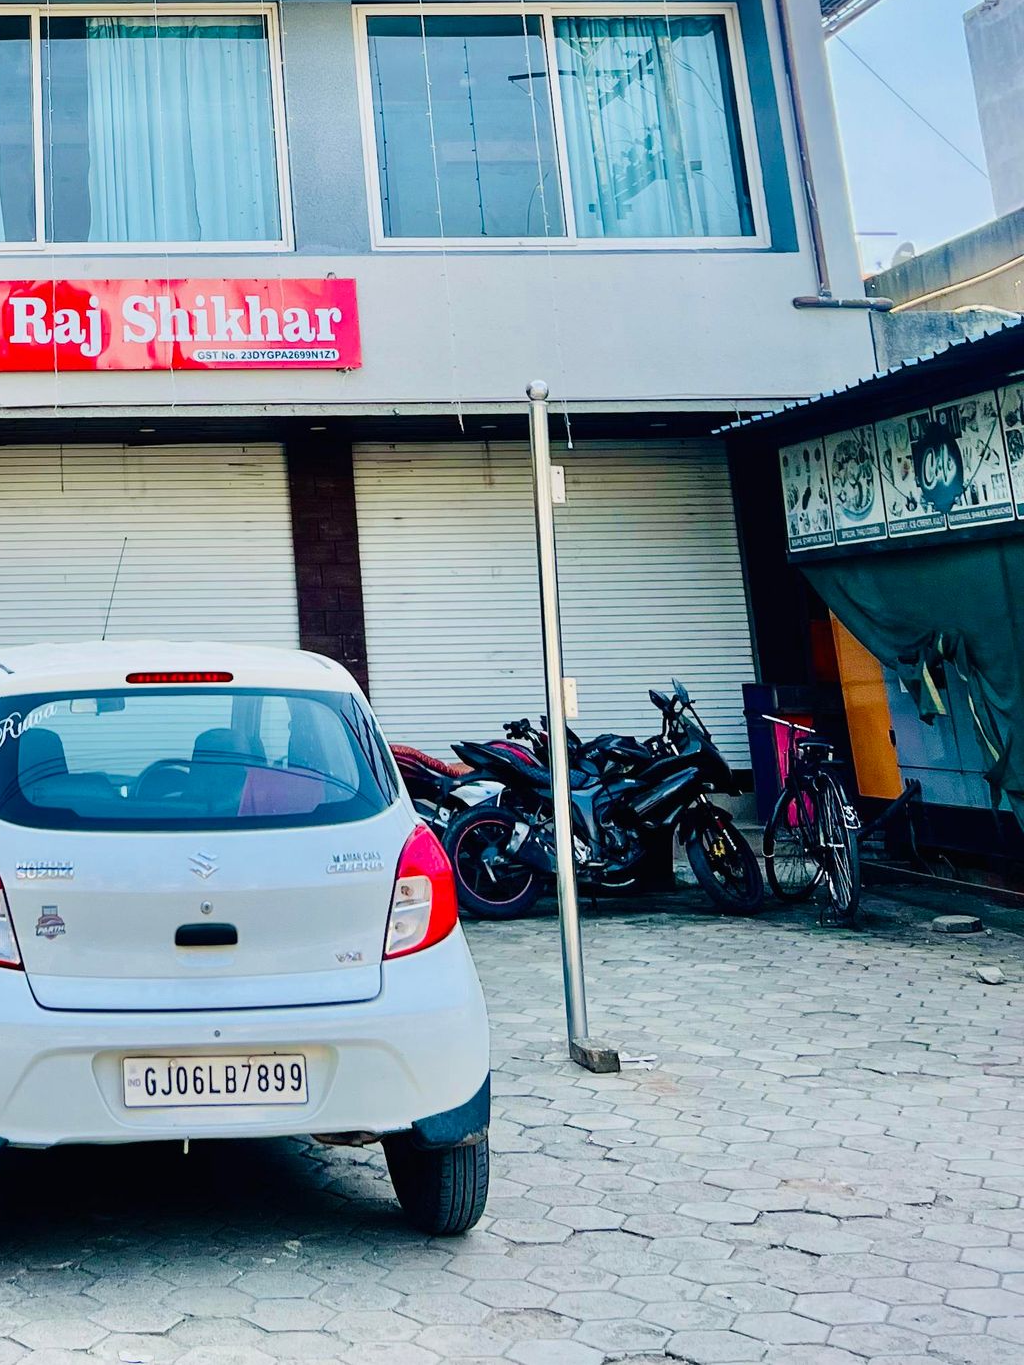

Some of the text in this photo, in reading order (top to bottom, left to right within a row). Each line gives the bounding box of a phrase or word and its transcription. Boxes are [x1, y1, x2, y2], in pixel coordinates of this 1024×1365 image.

[9, 294, 104, 358] Raj
[122, 294, 343, 344] Shikhar
[197, 351, 218, 361] GST
[222, 350, 238, 360] No.
[15, 869, 74, 880] SUZUKI
[144, 1063, 303, 1096] GJ06LB7899
